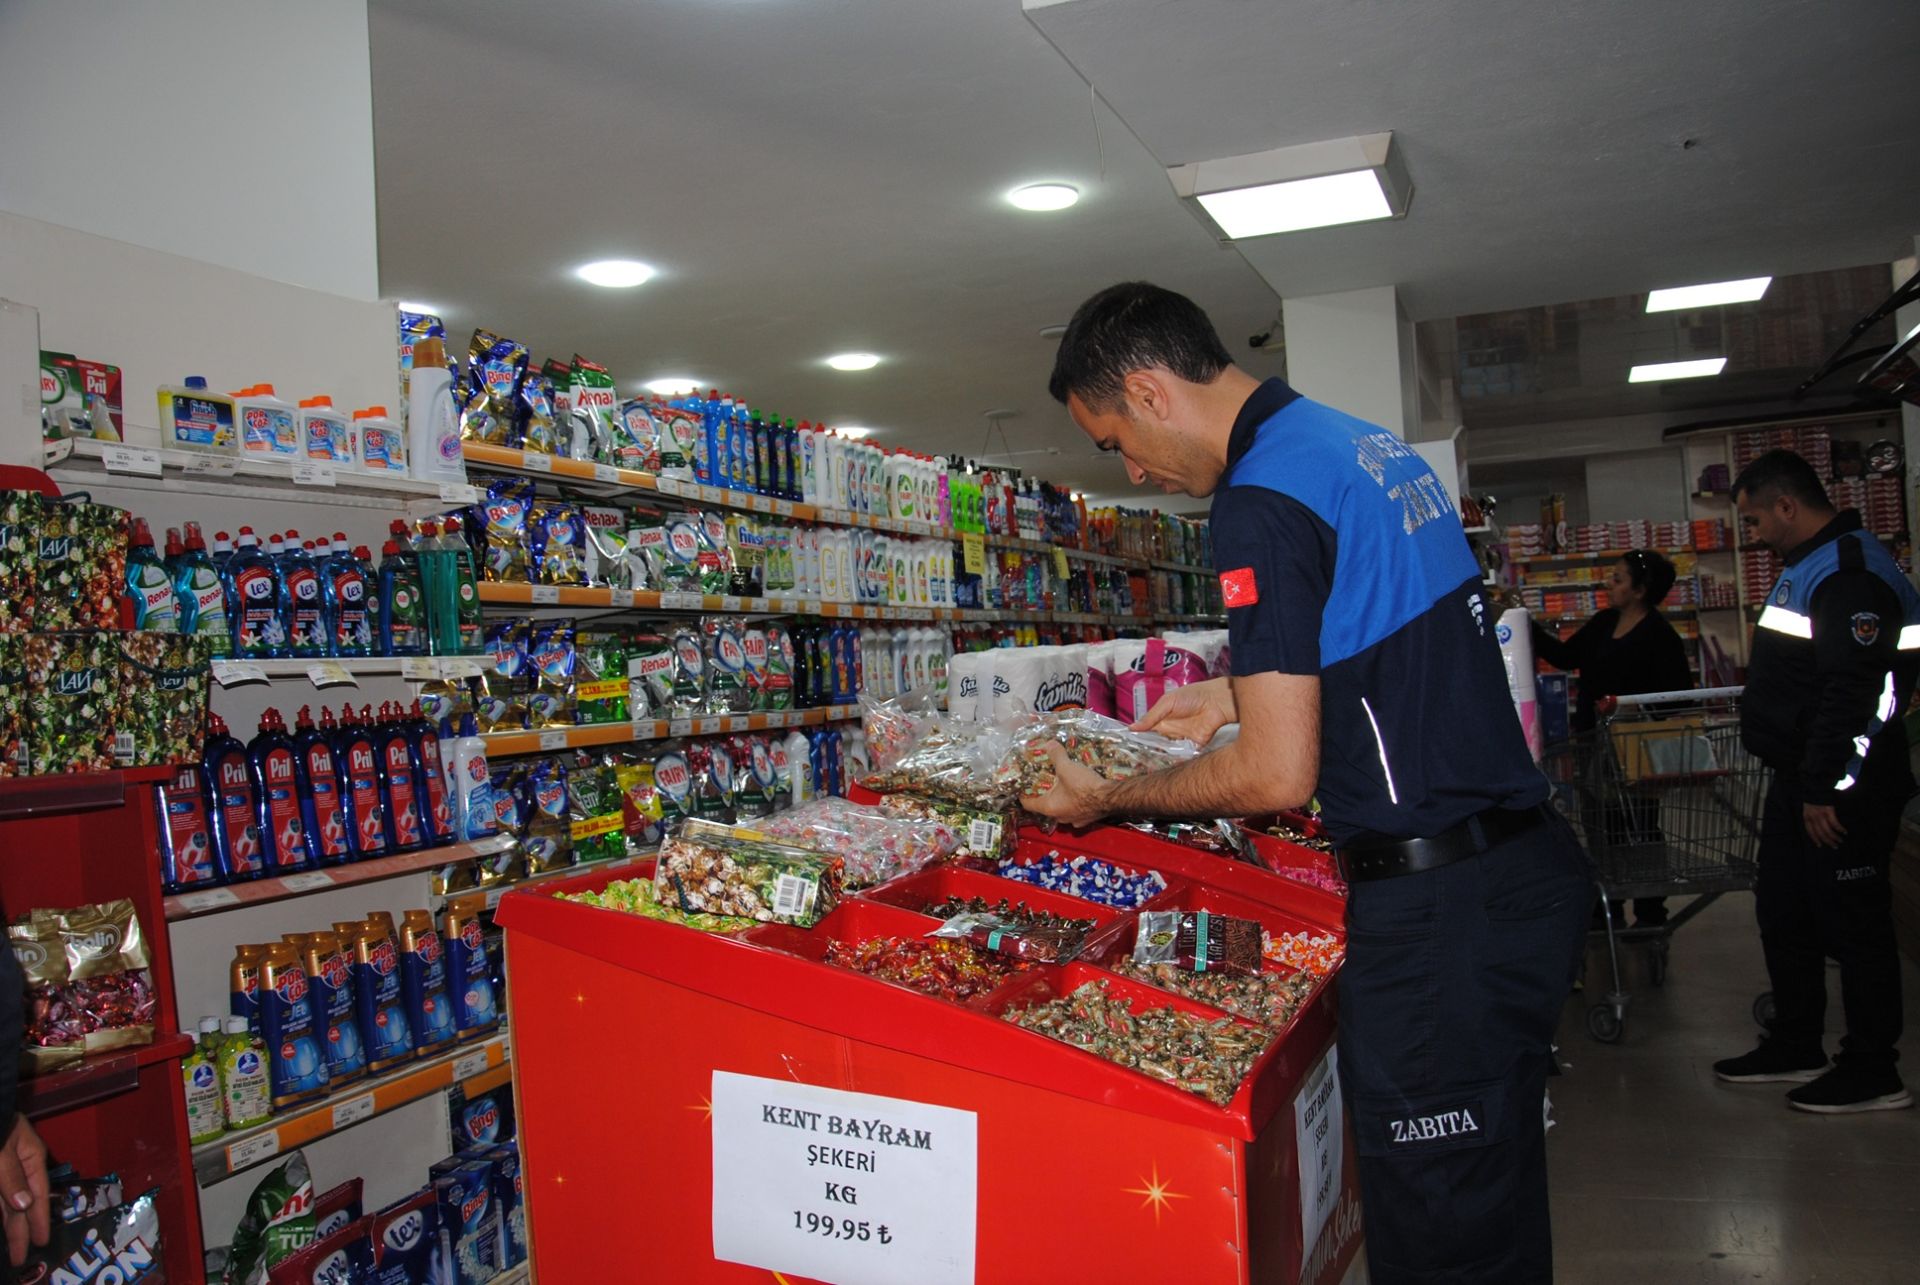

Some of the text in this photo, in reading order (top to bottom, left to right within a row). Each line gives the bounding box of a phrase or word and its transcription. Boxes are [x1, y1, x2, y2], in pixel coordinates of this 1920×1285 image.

[87, 376, 107, 394] Pril
[584, 510, 620, 526] Renax
[640, 657, 670, 674] Renax
[270, 757, 292, 778] Pril
[311, 752, 332, 772] Pril
[353, 750, 373, 769] Pril
[223, 763, 248, 784] Pril
[658, 766, 686, 787] FAIRY
[70, 930, 115, 950] bolin
[762, 1104, 933, 1150] KENT BAYRAM
[1390, 1108, 1479, 1142] ZABITA
[807, 1144, 876, 1173] ŞEKERİ
[825, 1182, 858, 1205] KG
[793, 1210, 871, 1241] 199,95
